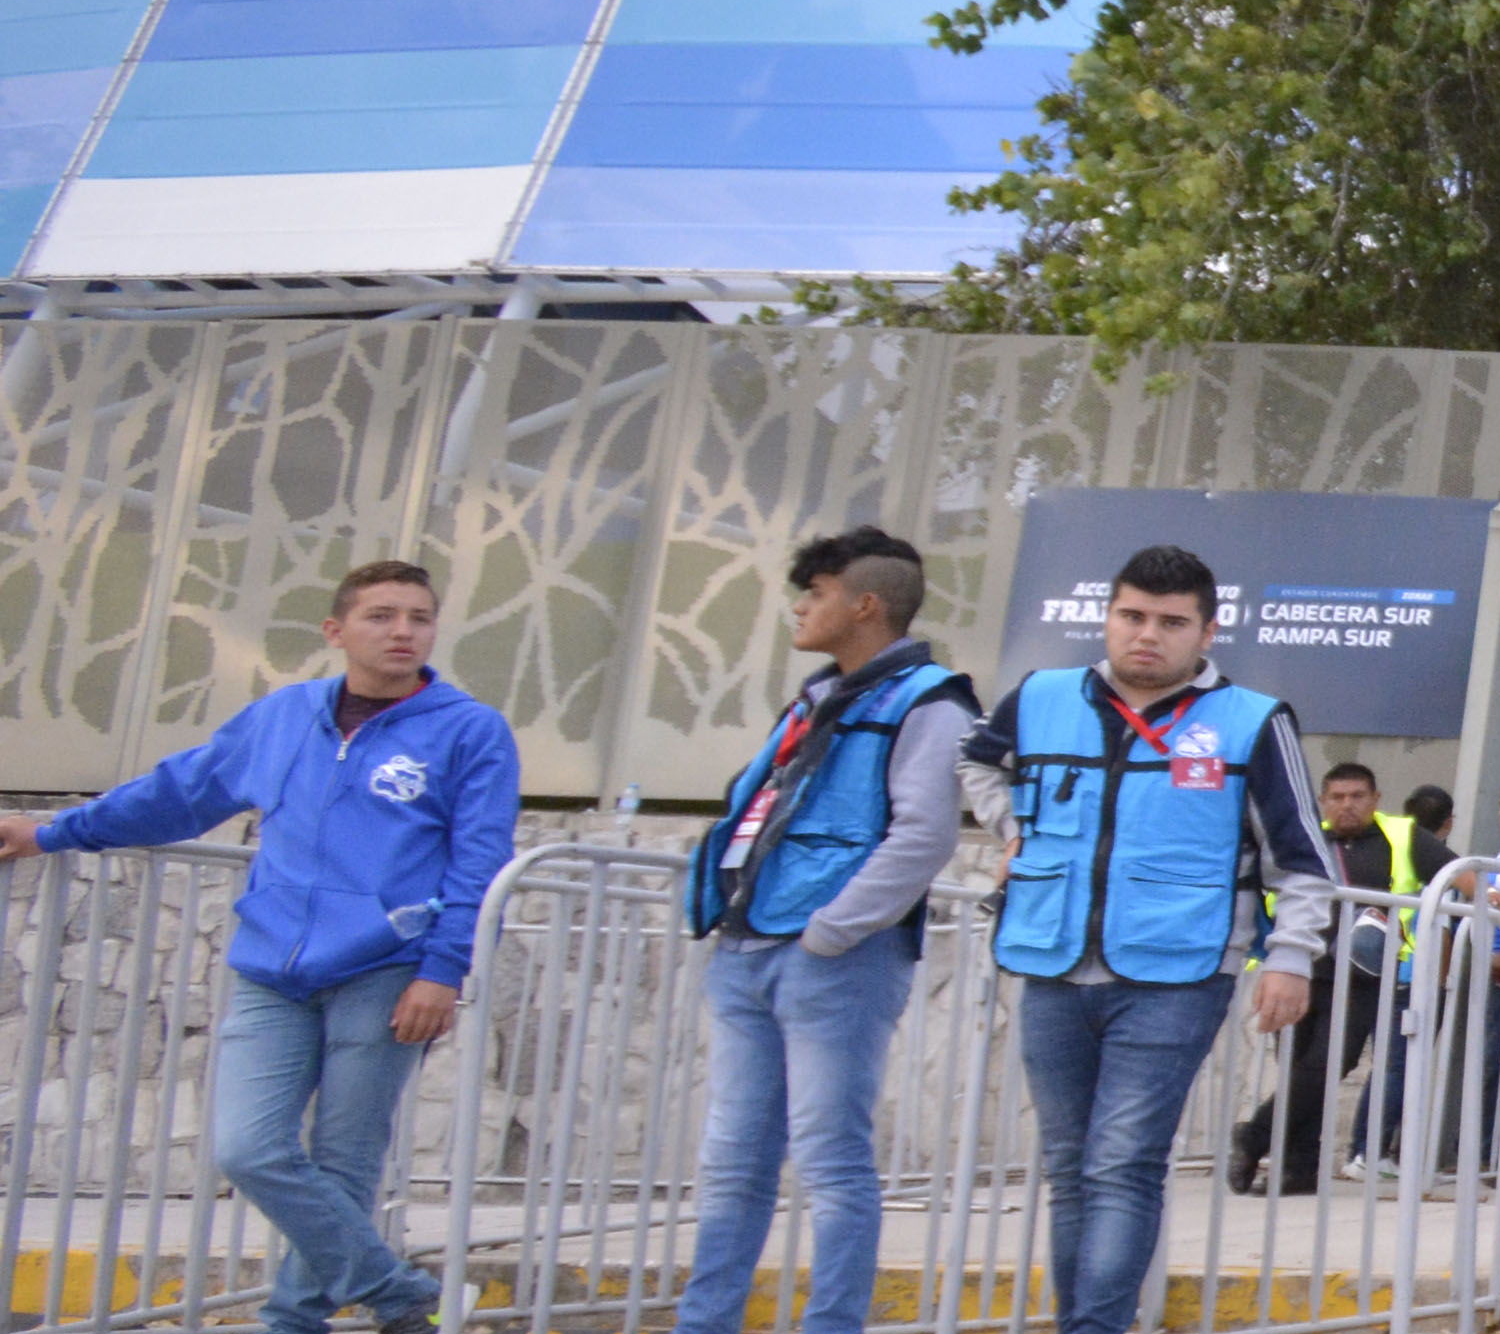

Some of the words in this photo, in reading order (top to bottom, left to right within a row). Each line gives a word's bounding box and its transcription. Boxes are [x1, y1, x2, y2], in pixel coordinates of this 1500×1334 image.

[1260, 603, 1379, 624] CABECERA
[1383, 607, 1432, 626] SUR
[1257, 626, 1339, 646] RAMPA
[1343, 629, 1392, 647] SUR
